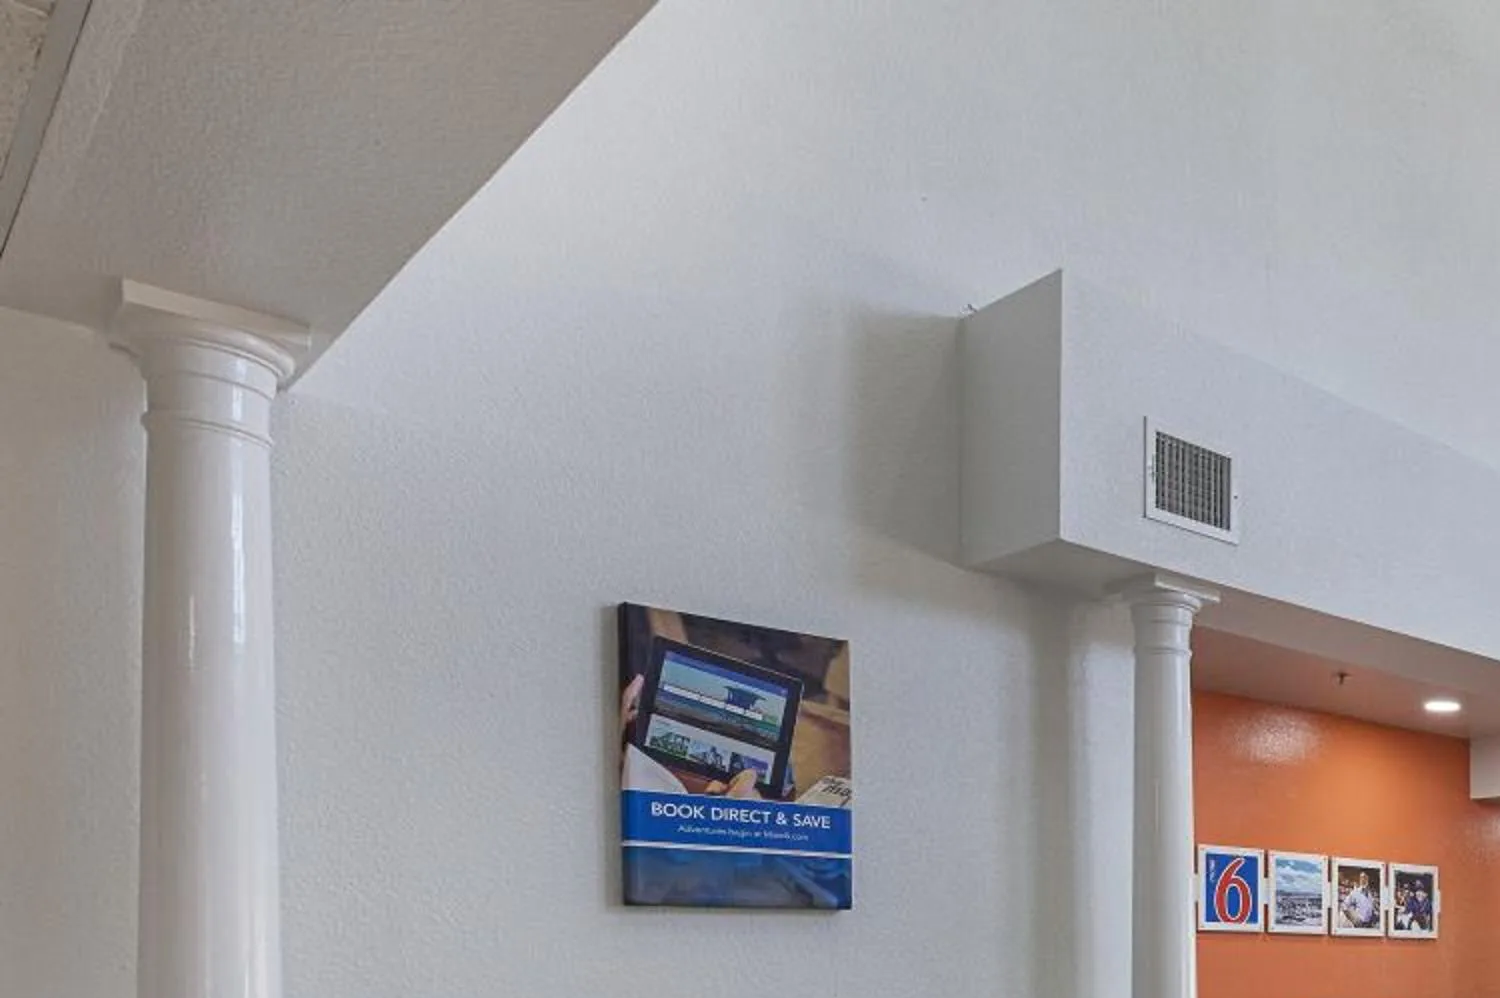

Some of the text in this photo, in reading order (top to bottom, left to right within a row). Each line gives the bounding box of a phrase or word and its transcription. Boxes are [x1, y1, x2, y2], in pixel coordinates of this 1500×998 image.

[650, 801, 831, 829] BOOK DIRECT & SAVE
[1214, 857, 1252, 926] 6
